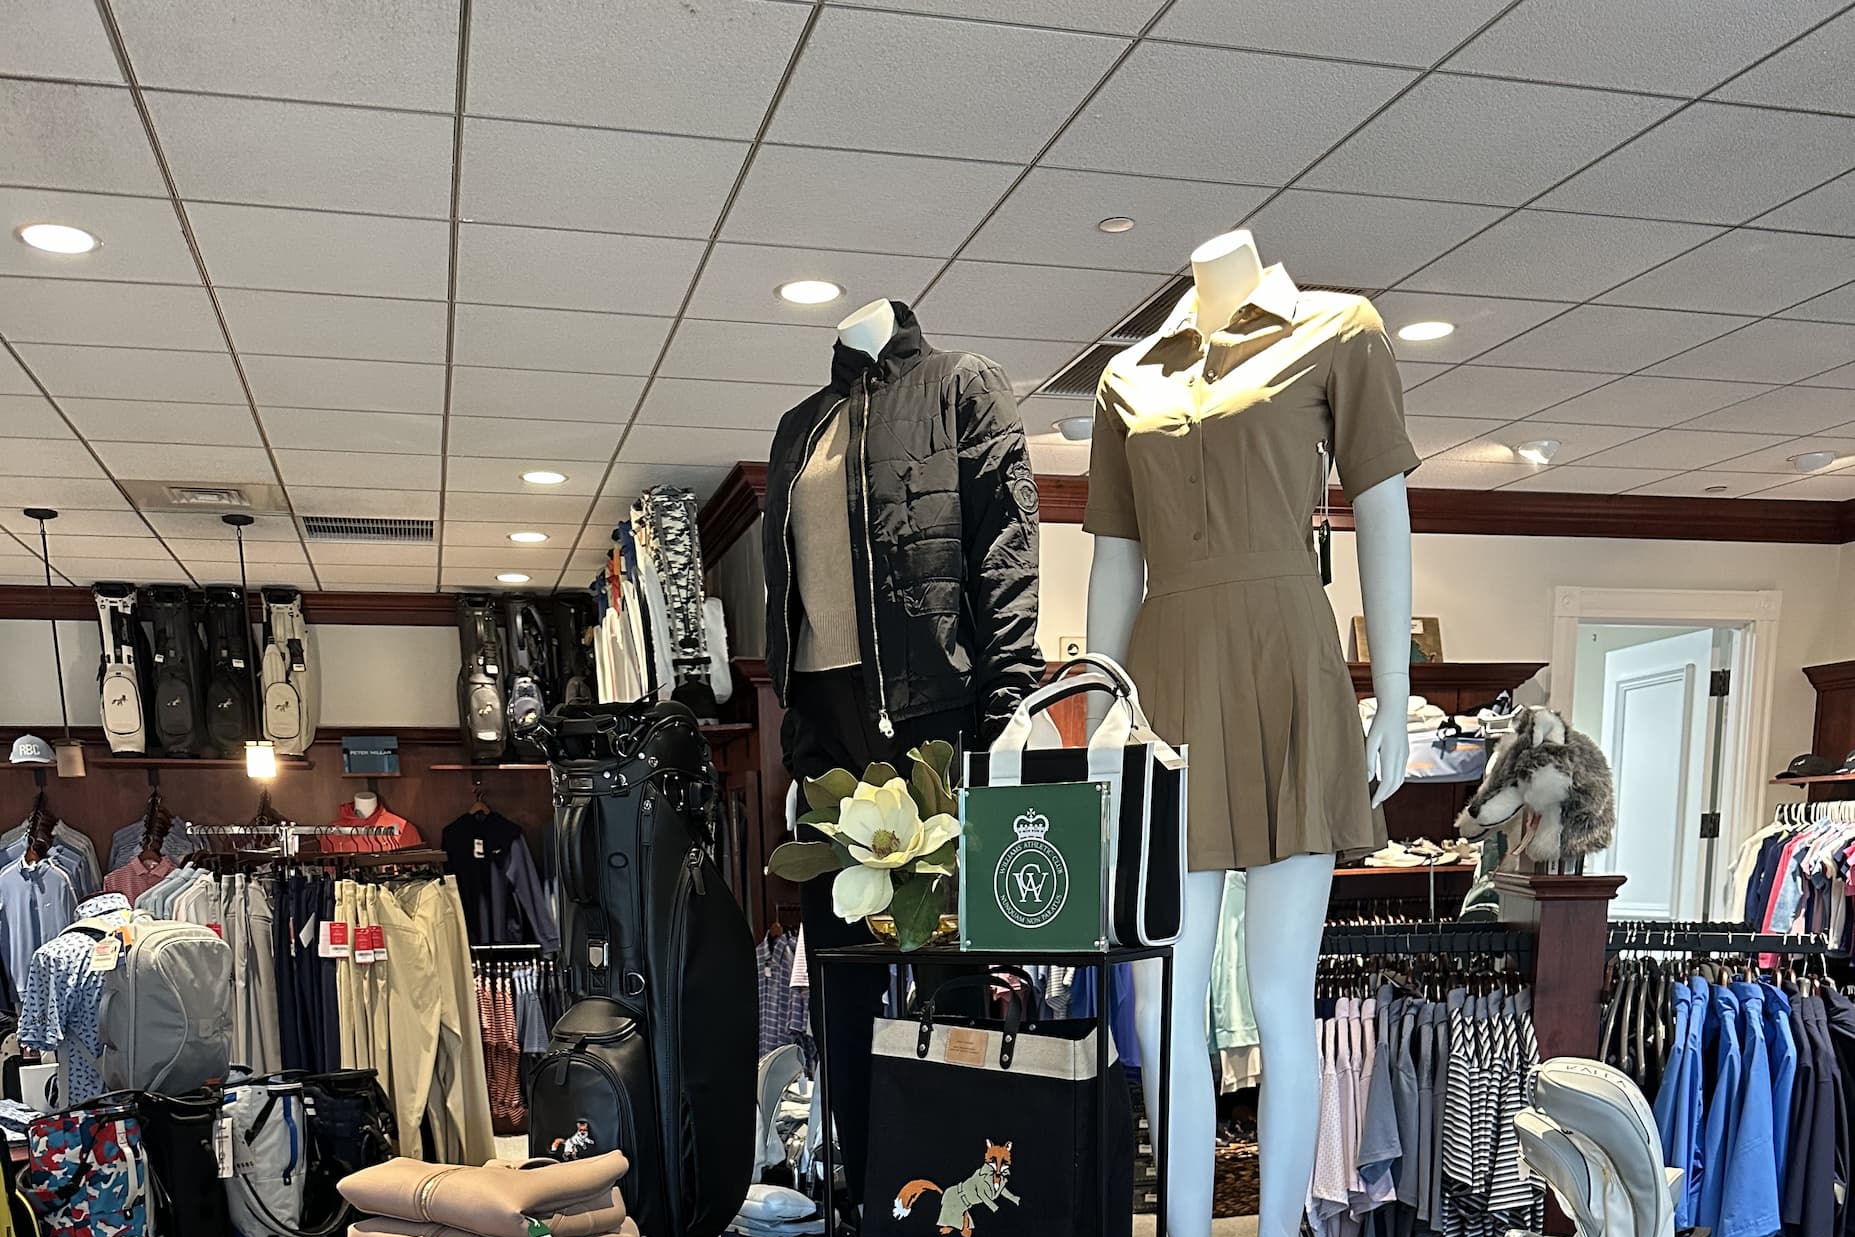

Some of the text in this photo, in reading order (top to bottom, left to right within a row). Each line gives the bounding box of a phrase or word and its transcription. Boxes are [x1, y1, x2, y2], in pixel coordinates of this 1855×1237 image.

[19, 743, 41, 757] RBC
[999, 841, 1063, 875] WILLIAMS ATHLETIC CLUB
